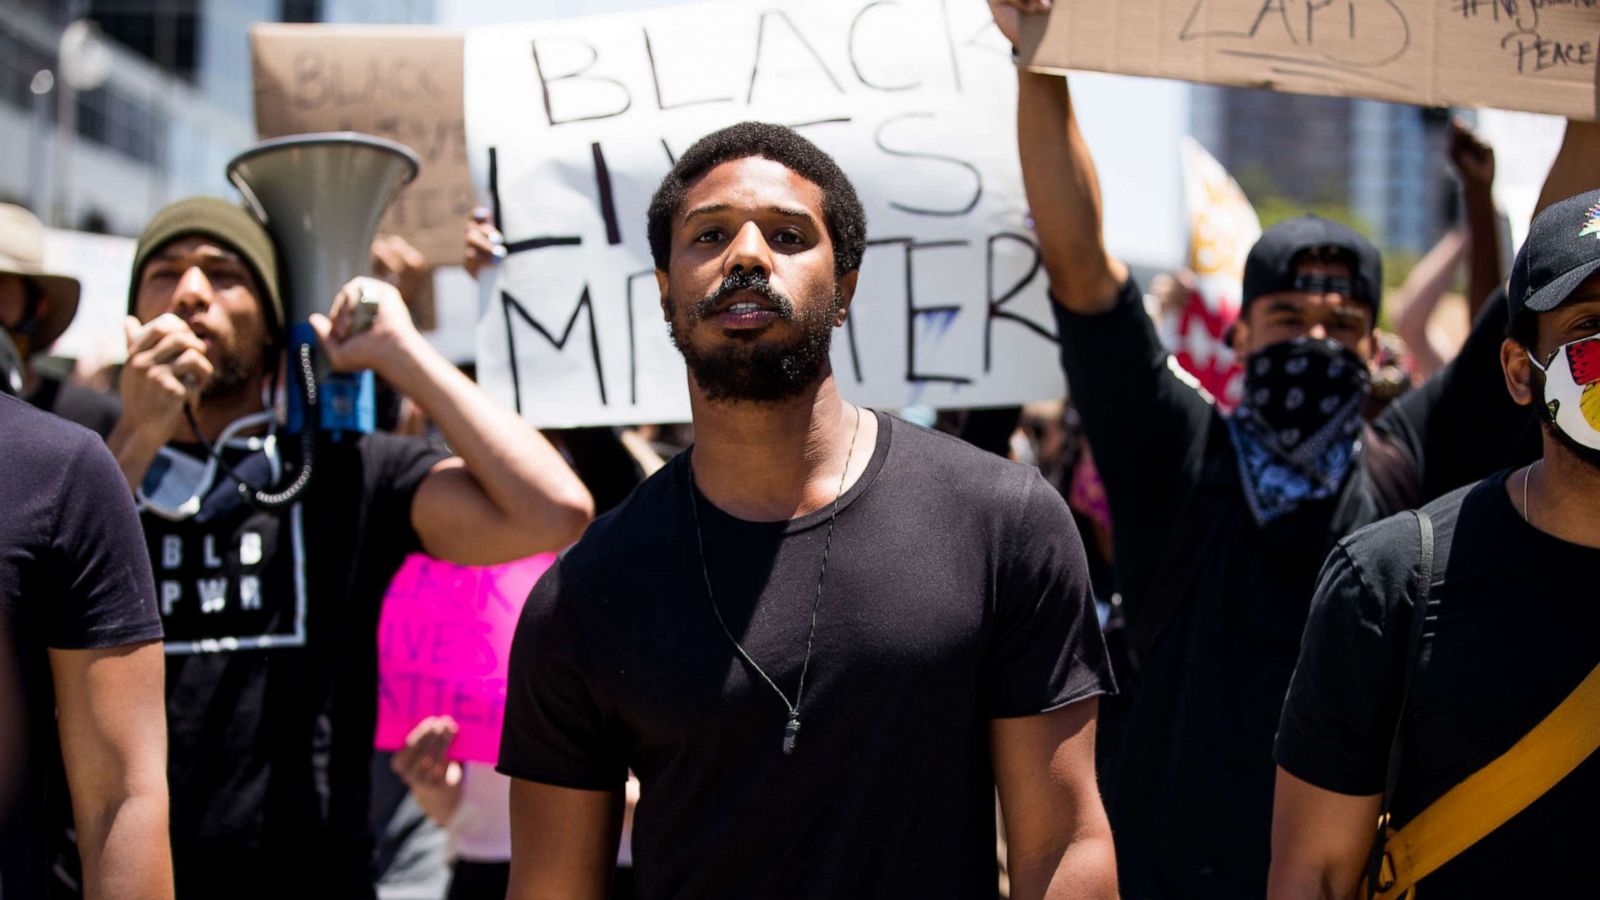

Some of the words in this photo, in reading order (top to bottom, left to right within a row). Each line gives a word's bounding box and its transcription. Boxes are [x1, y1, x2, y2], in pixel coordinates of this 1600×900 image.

[530, 0, 1008, 126] BLACK
[1500, 31, 1596, 74] PEACE
[487, 111, 984, 251] LIS
[500, 231, 1061, 417] MTER
[160, 575, 262, 615] PWR
[383, 619, 499, 677] IVES
